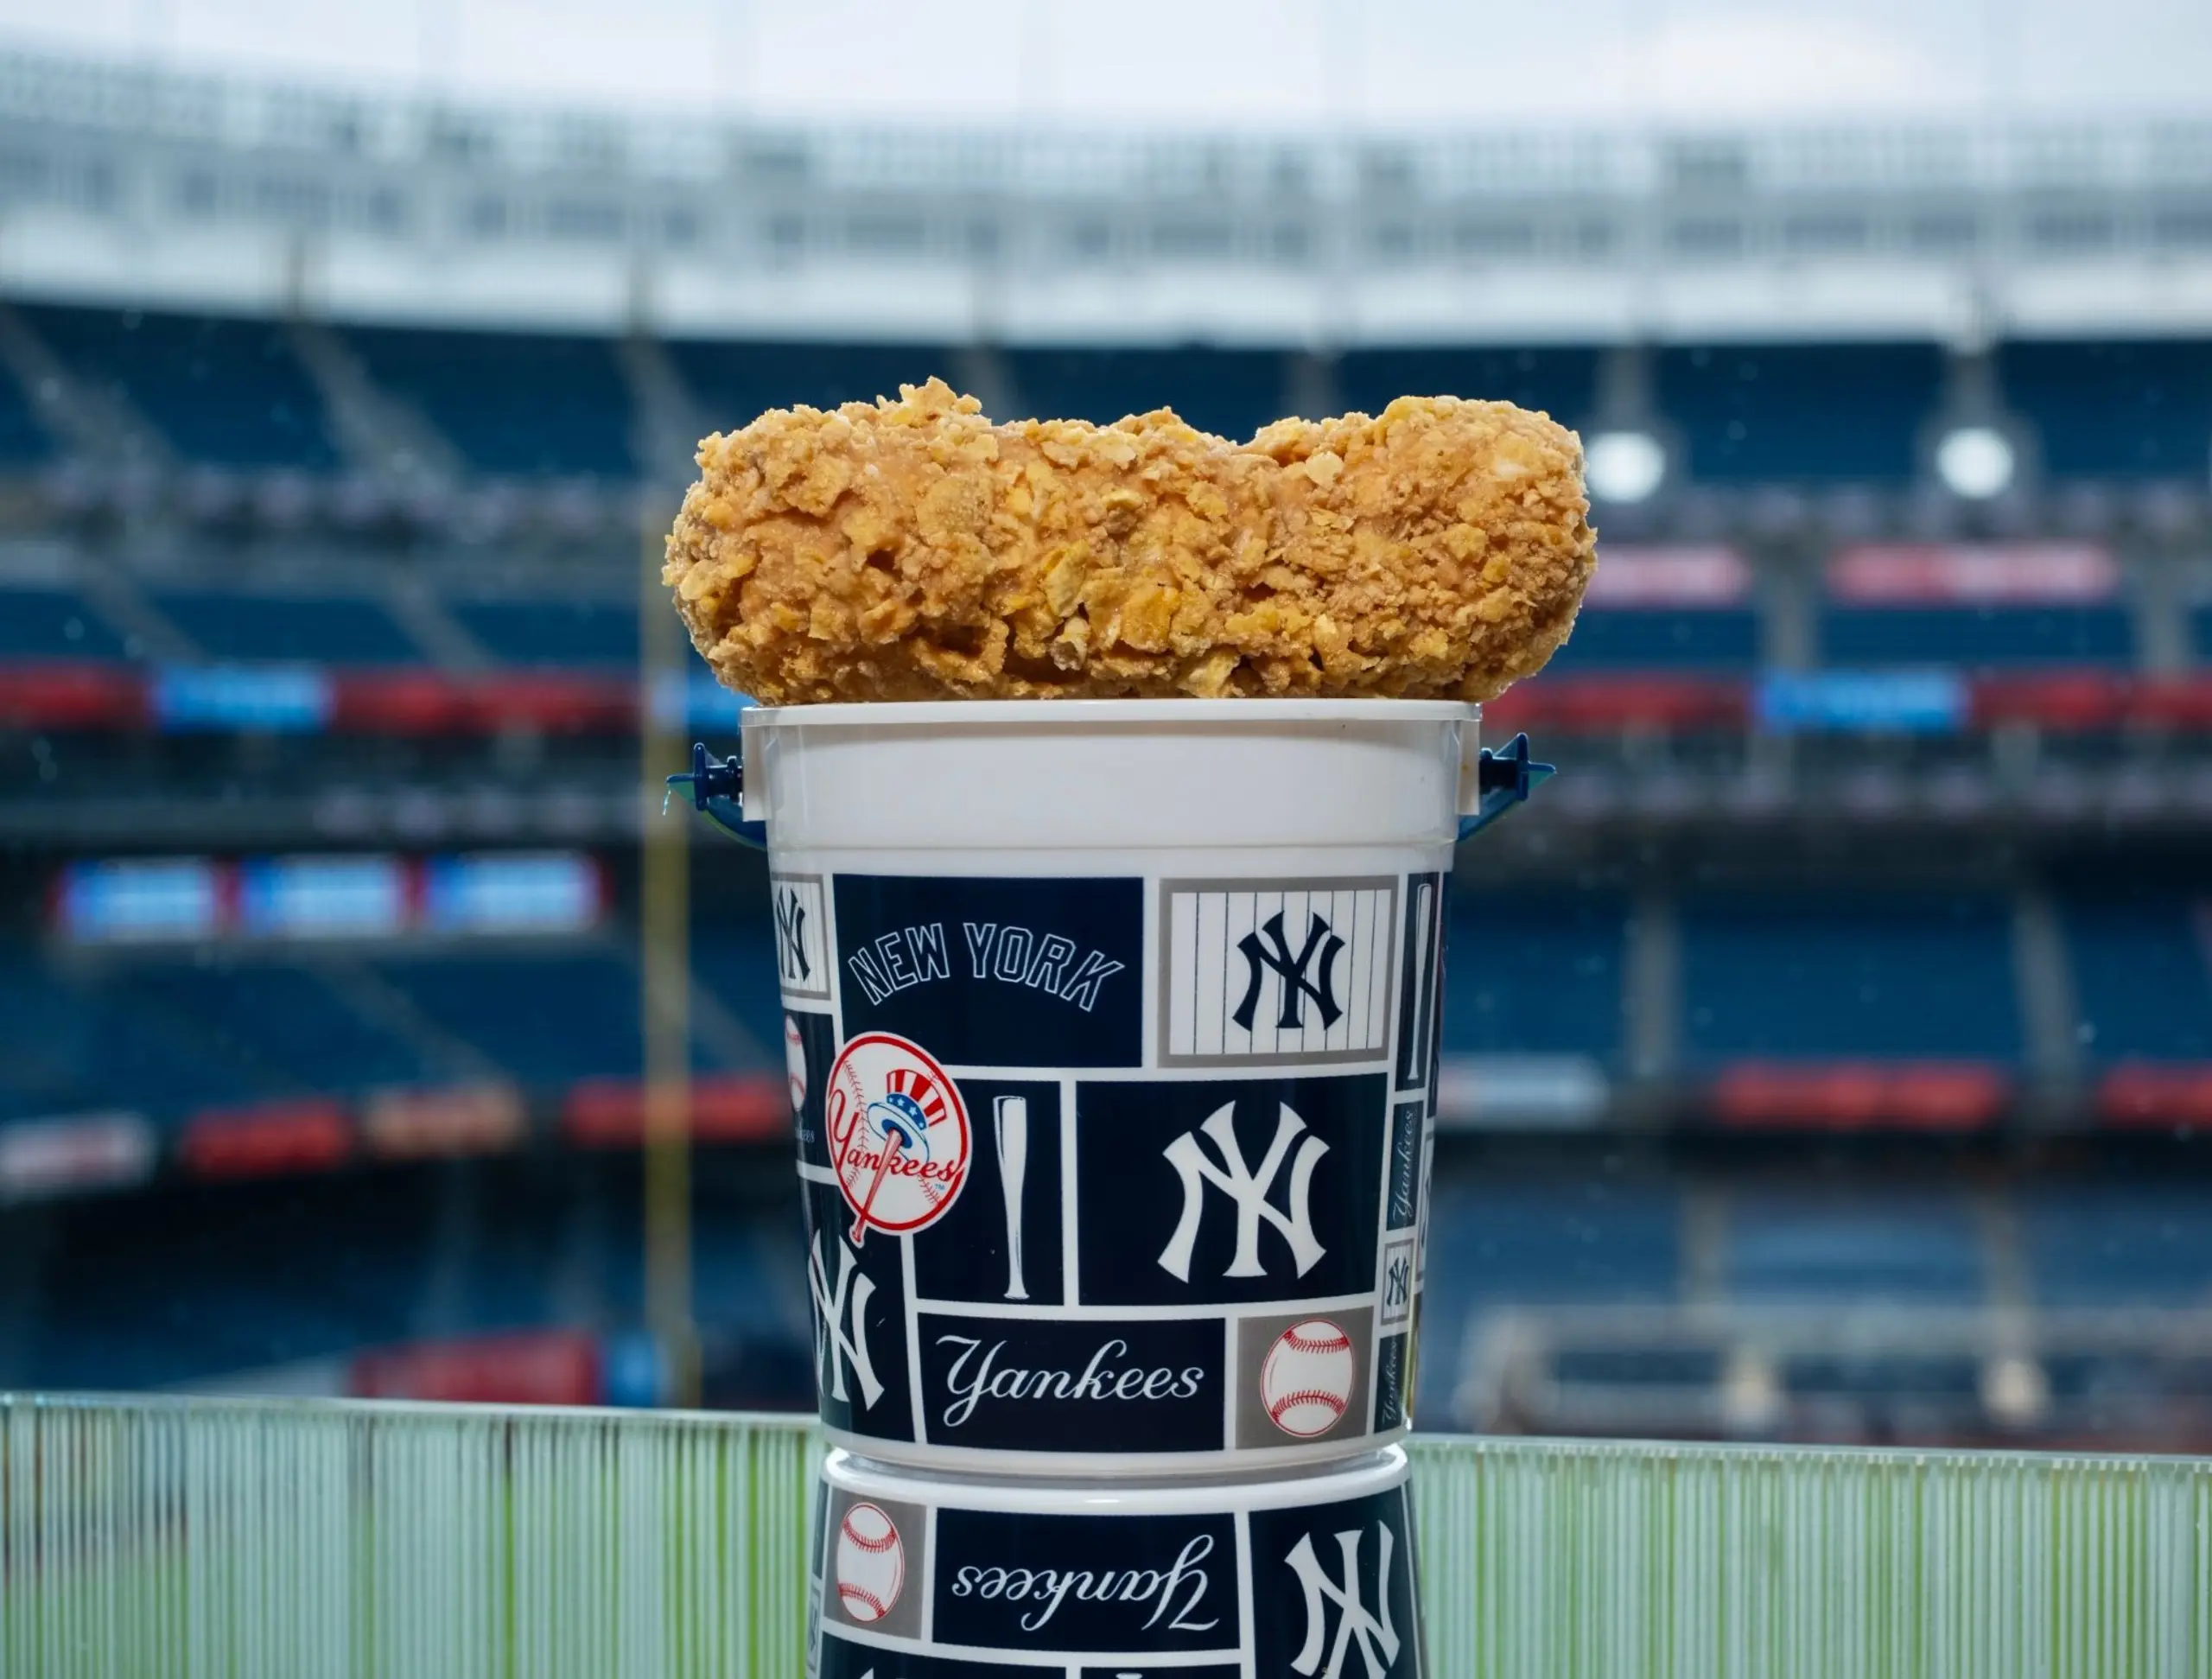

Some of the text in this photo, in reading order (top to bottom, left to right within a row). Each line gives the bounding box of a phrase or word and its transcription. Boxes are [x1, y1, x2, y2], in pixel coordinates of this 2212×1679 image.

[849, 922, 1125, 1012] NEW YORK
[1232, 910, 1345, 1032] NY
[829, 1089, 962, 1182] Yankees
[1157, 1099, 1331, 1284] NY
[1386, 1256, 1409, 1307] NY
[935, 1334, 1205, 1427] Yankees
[951, 1534, 1219, 1631] Yankees
